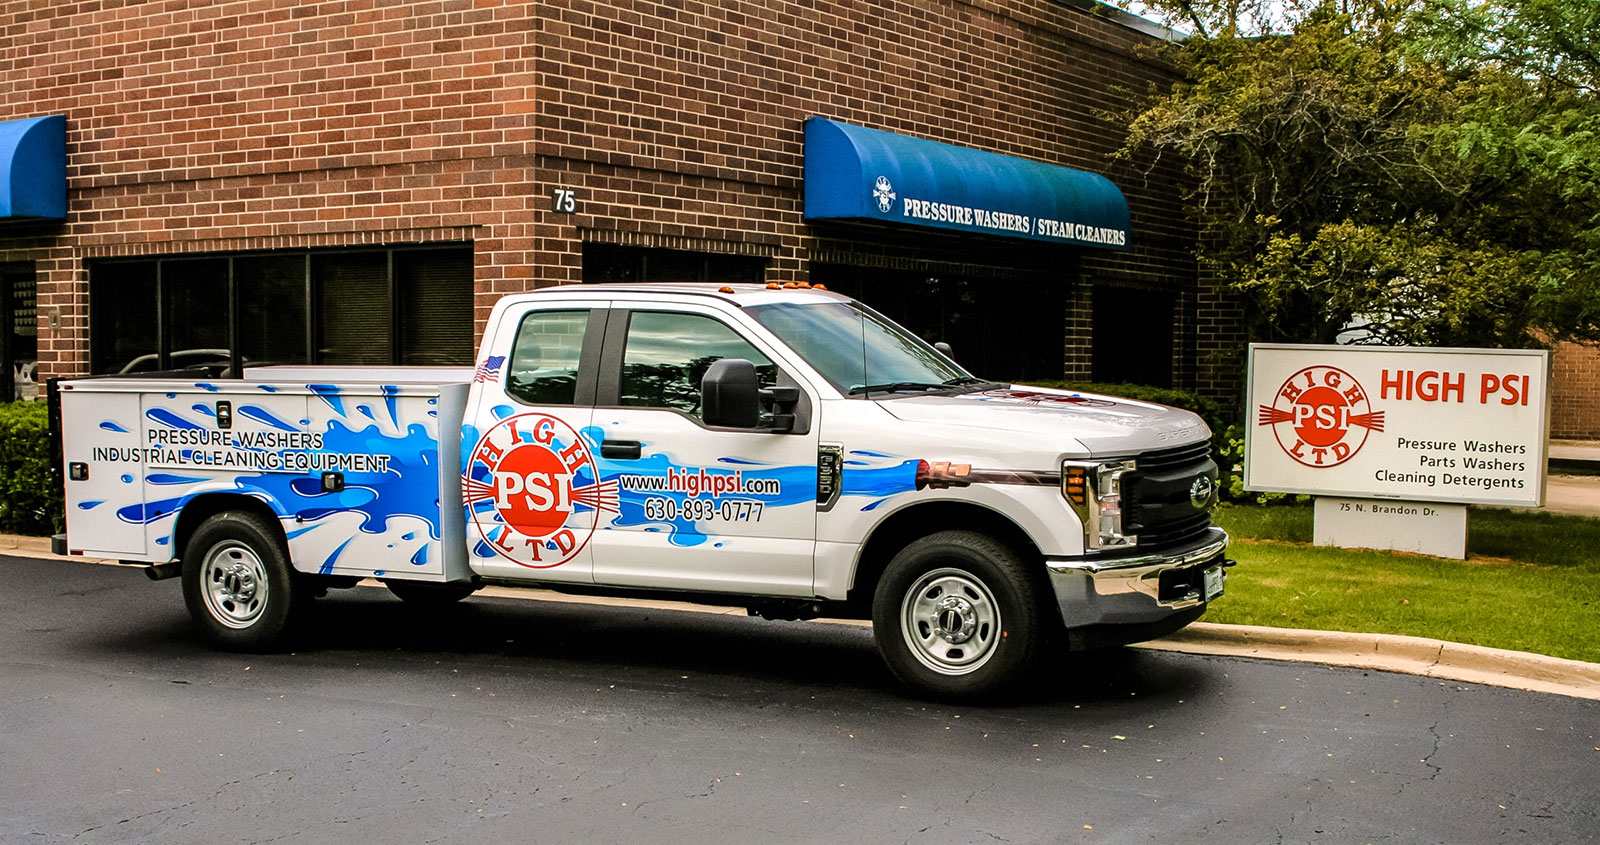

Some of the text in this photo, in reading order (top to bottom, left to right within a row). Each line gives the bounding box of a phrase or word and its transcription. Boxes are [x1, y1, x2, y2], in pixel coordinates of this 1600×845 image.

[554, 189, 575, 212] 75
[903, 198, 1126, 246] PRESSURE WASHERS / STEAM CLEANERS
[1281, 371, 1364, 407] HIGH
[1380, 369, 1529, 406] HIGH PSI
[1294, 404, 1349, 430] PSI
[148, 429, 323, 449] PRESSURE WASHERS
[476, 418, 590, 475] HIGH
[1290, 439, 1350, 464] LTD
[1397, 437, 1526, 454] Pressure Washers
[93, 447, 390, 472] INDUSTRIAL CLEANING EQUIPMENT
[1420, 455, 1525, 471] Parts Washers
[494, 471, 574, 512] PSI
[621, 468, 780, 497] www.highpsi.com
[1375, 470, 1524, 490] Cleaning Detergents
[645, 499, 765, 523] 630-893-0777
[1340, 503, 1439, 517] 75 N. Brandon Dr.
[495, 525, 576, 562] LTD
